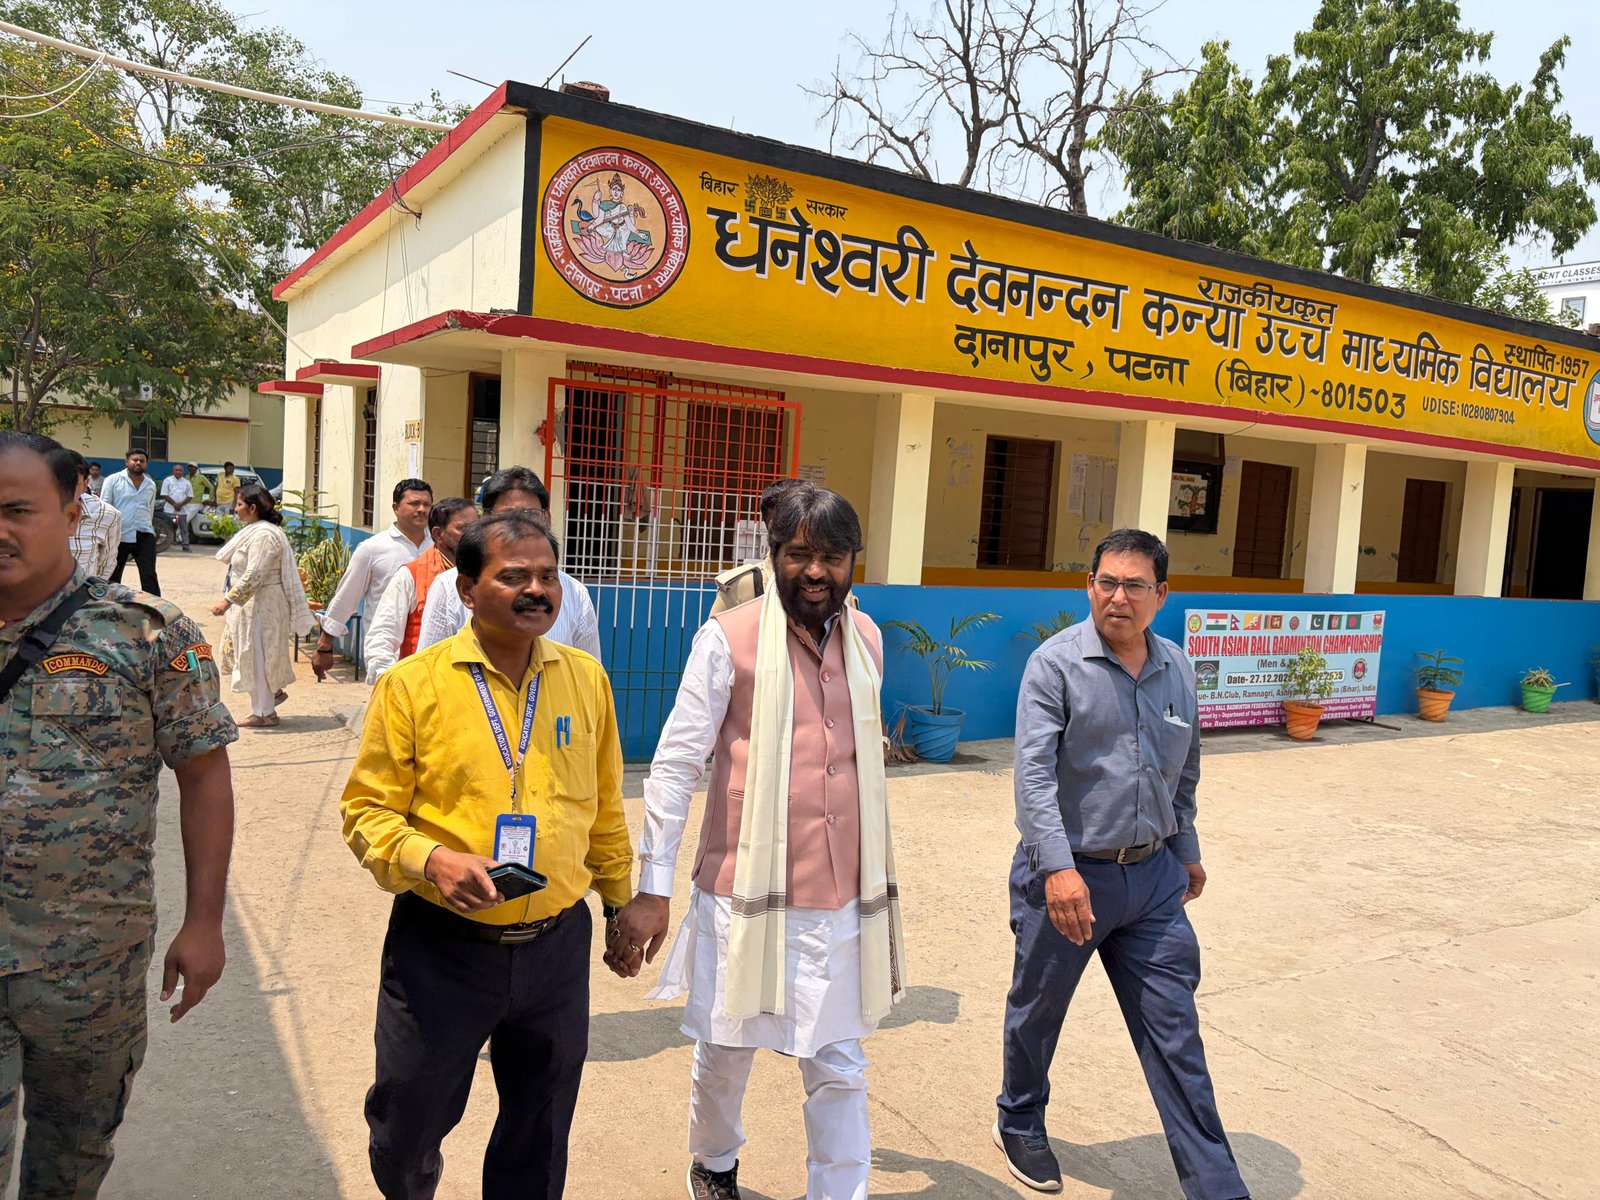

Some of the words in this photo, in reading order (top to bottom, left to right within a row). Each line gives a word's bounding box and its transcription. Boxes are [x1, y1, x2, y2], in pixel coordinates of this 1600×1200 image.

[622, 154, 654, 180] कन्या
[649, 174, 671, 197] उच्च
[698, 171, 740, 198] बिहार
[806, 198, 848, 221] सरकार
[610, 284, 644, 301] पटना
[1197, 276, 1338, 326] राजकीयकृत
[706, 206, 937, 307] धनेश्वरी
[946, 240, 1130, 332] देवनन्दन
[1142, 288, 1248, 351] कन्या
[1256, 312, 1332, 365] उच्च
[1342, 329, 1462, 387] माध्यमिक
[1470, 343, 1577, 411] विद्यालय
[1104, 346, 1190, 386] पटना
[1188, 635, 1220, 657] SOUTH
[1221, 635, 1250, 656] ASIAN
[1250, 635, 1272, 656] BALL
[1272, 634, 1322, 655] BADMINTON
[1323, 633, 1383, 654] CHAMPIONSHIP
[49, 655, 107, 672] COMMANDO
[1257, 659, 1277, 670] (Men
[1280, 659, 1286, 667] &
[1226, 675, 1249, 685] Date-
[1362, 684, 1376, 692] India
[477, 681, 496, 717] GOVERNMENT
[1214, 718, 1247, 728] Auspicious
[1320, 710, 1351, 720] EDERATION
[520, 717, 532, 750] EDUCATION
[496, 733, 512, 767] EDUCATION
